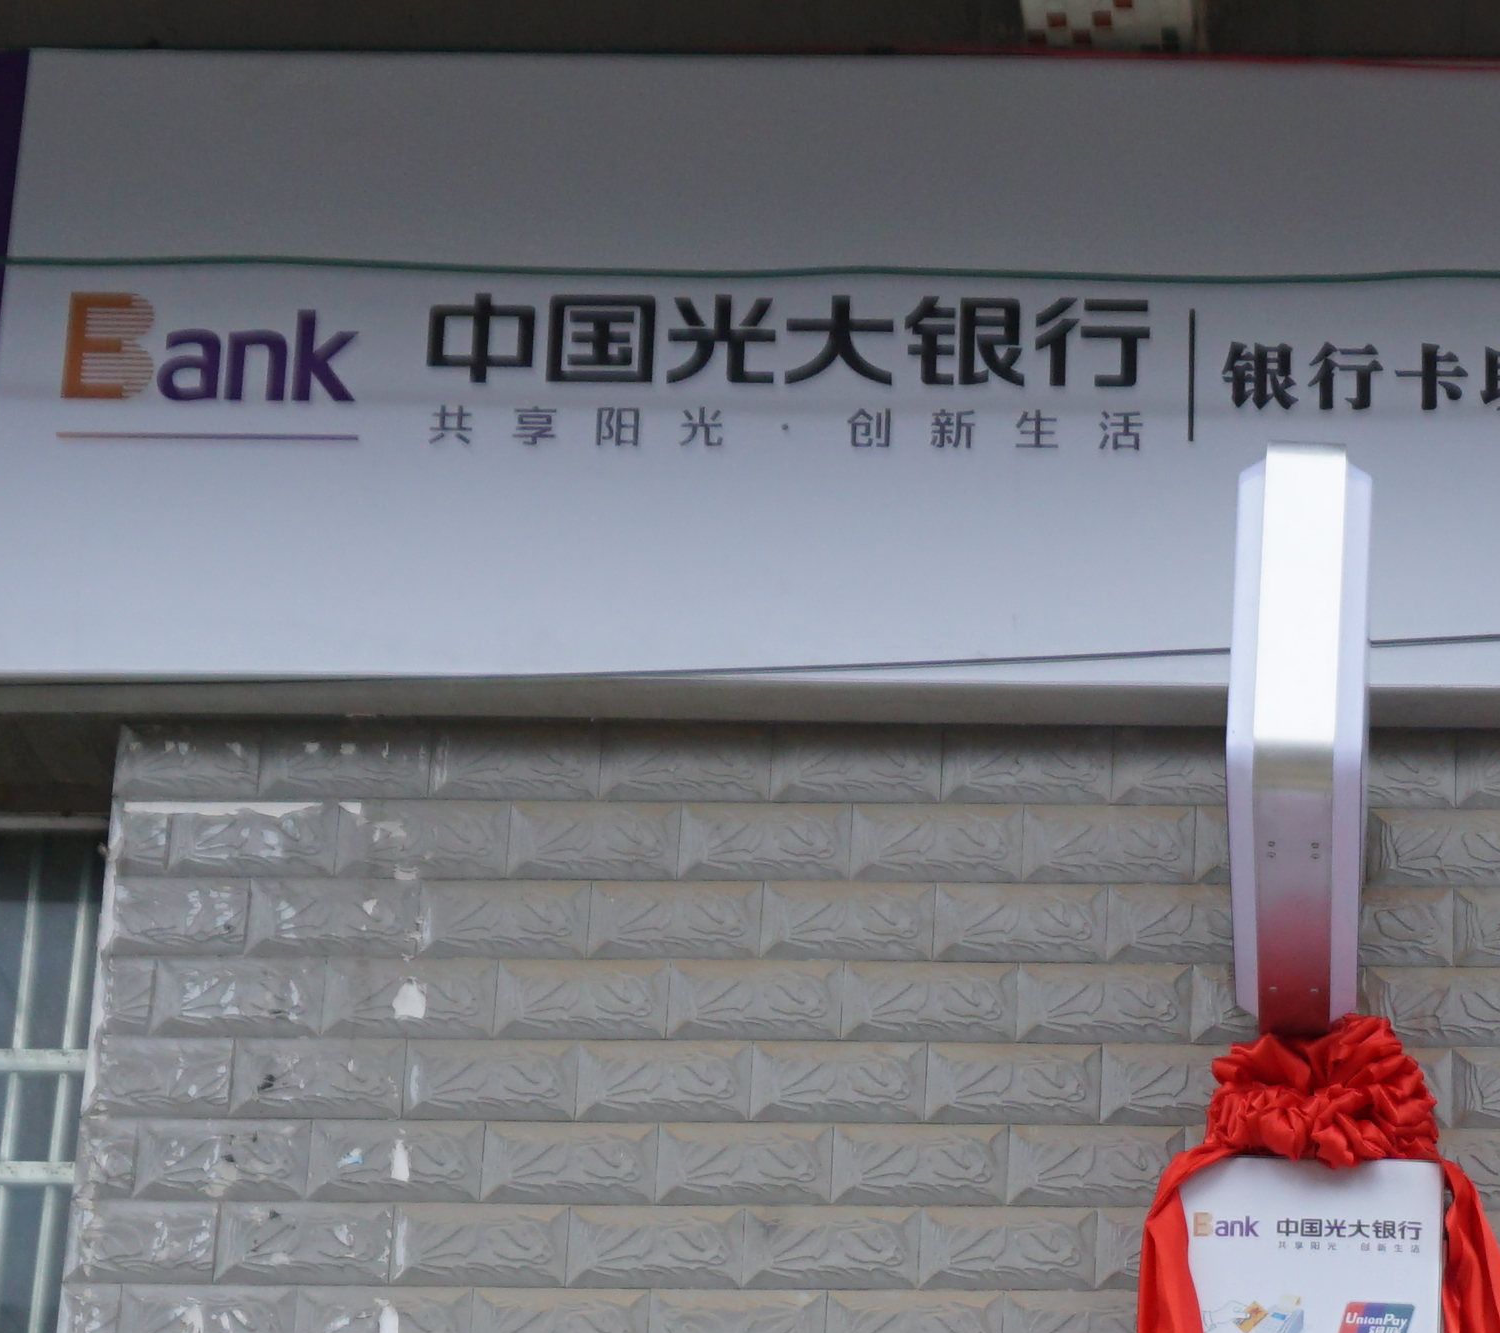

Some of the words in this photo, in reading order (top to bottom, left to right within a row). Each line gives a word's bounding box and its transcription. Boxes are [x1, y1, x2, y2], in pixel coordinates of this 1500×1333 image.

[60, 290, 360, 404] Bank
[425, 292, 1151, 390] 中国光大银行
[1193, 1212, 1260, 1238] Bank
[1276, 1217, 1422, 1241] 中国光大银行
[1346, 1312, 1407, 1330] UnionPay
